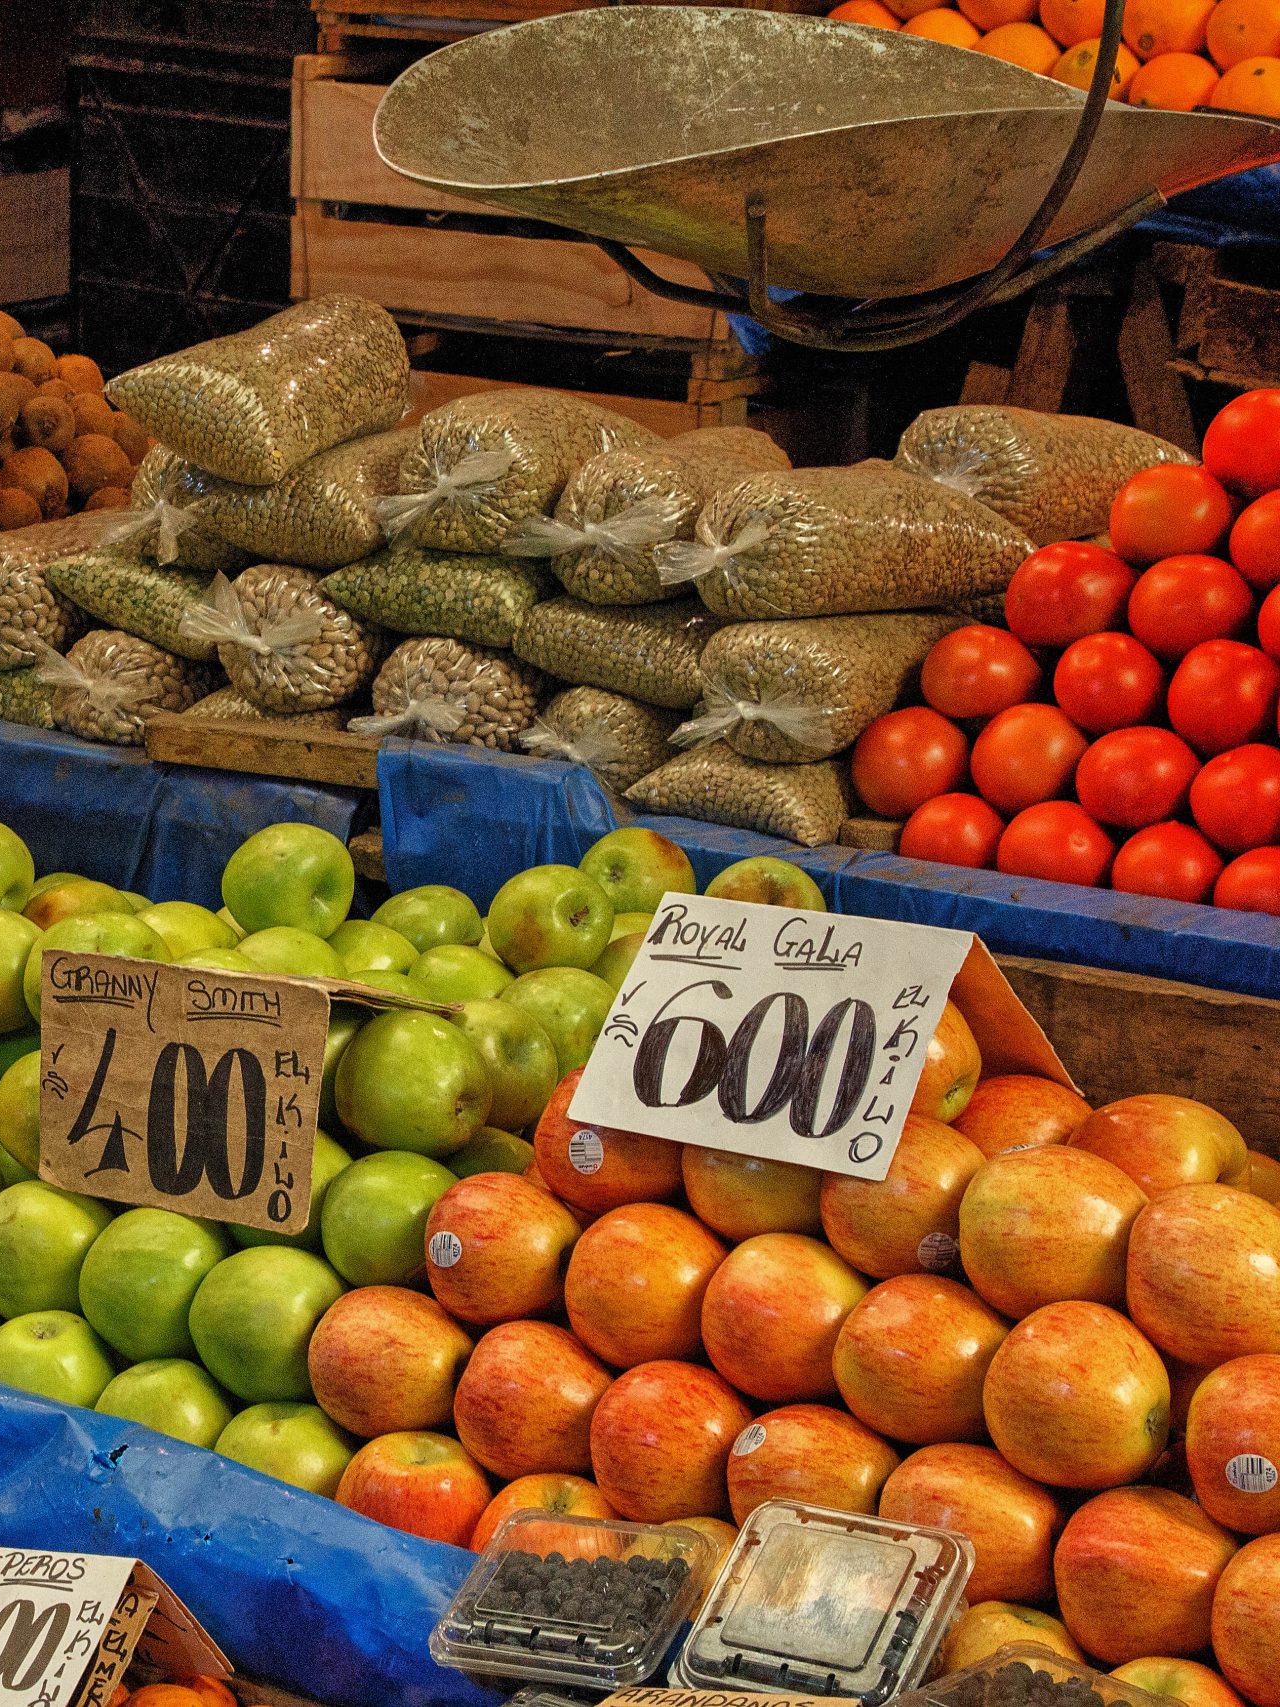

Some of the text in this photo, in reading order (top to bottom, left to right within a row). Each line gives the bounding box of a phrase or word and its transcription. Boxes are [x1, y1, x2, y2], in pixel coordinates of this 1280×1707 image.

[648, 904, 863, 967] ROYAL GALA
[50, 957, 281, 1034] GRANNY SMITH
